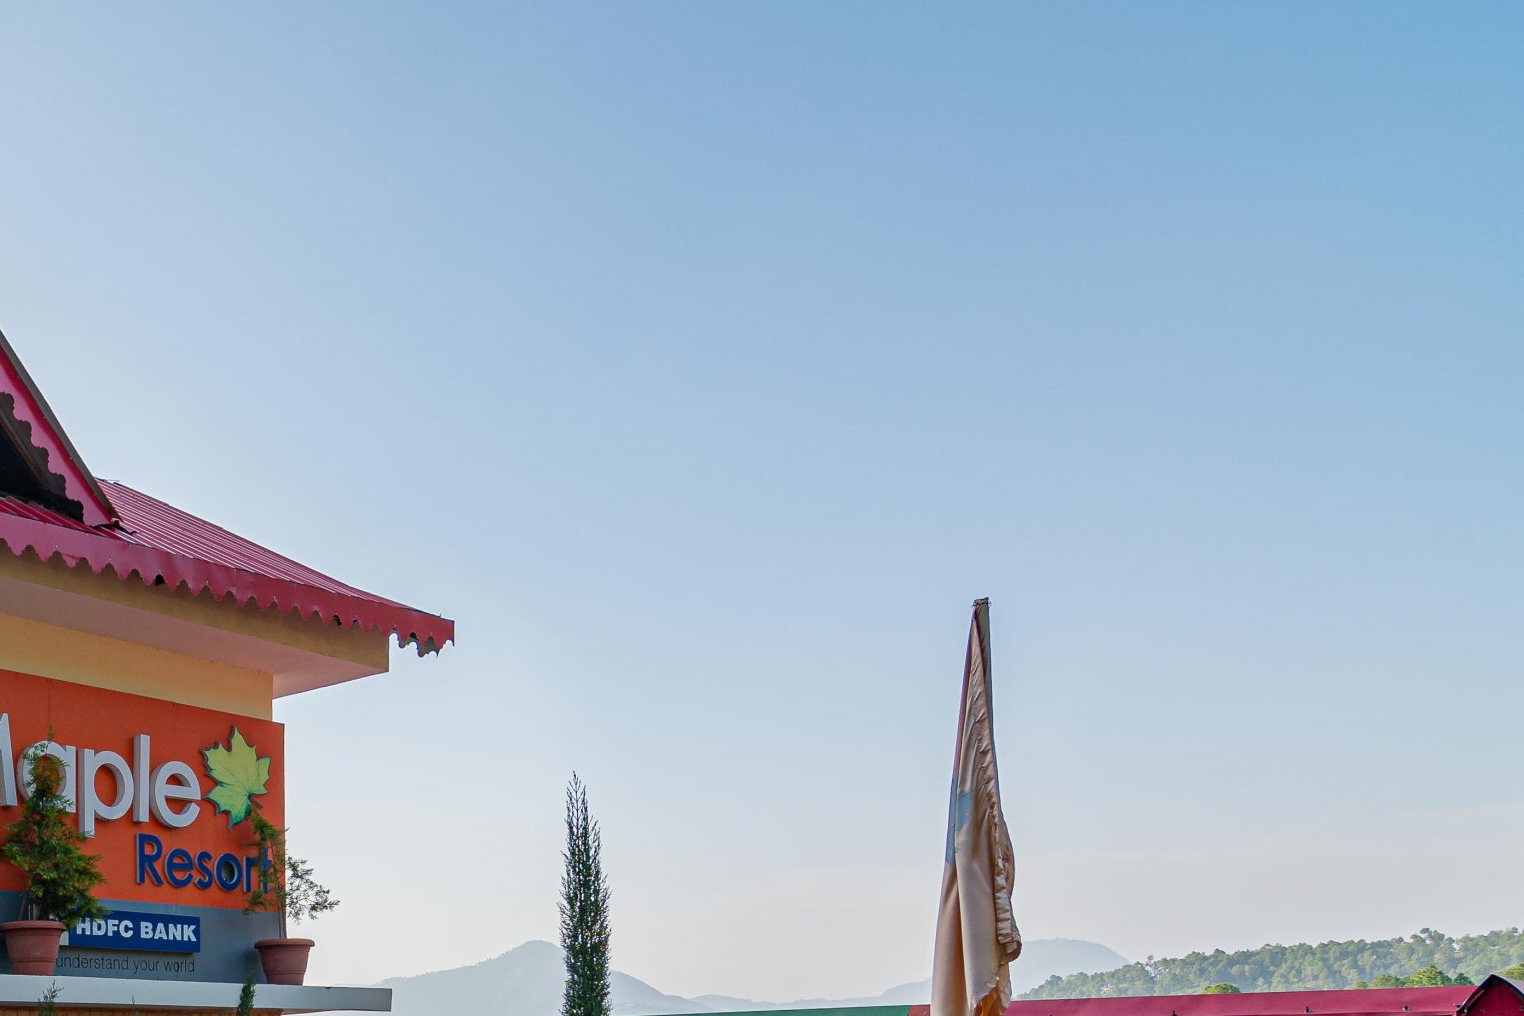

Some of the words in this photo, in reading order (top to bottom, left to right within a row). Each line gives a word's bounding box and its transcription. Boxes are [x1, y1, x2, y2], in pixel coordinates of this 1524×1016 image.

[135, 832, 272, 894] Resort
[76, 918, 134, 938] HDFC
[140, 921, 197, 941] BANK
[56, 954, 129, 970] understand
[132, 959, 160, 974] your
[163, 958, 195, 973] world
